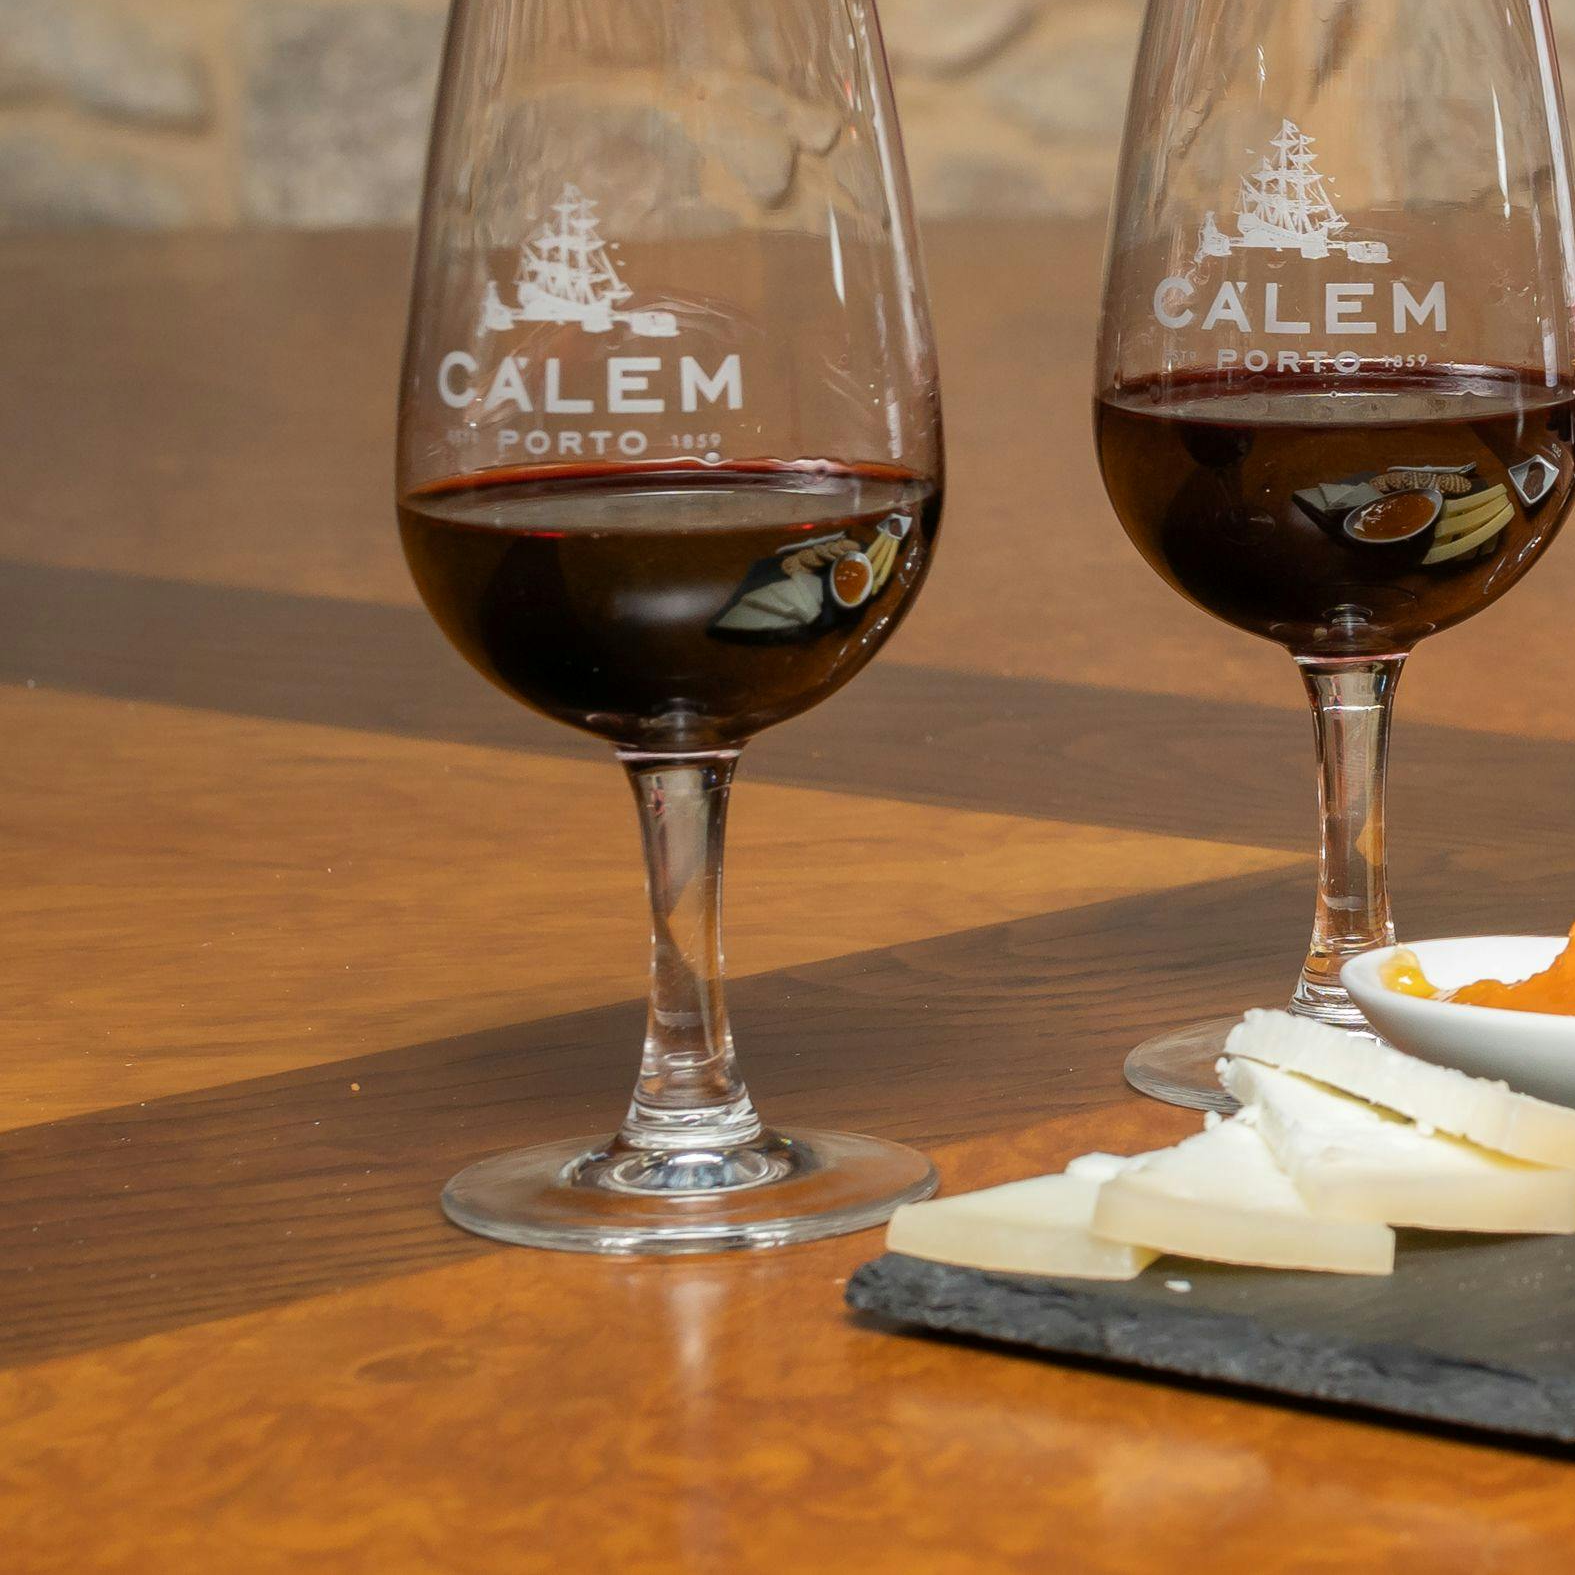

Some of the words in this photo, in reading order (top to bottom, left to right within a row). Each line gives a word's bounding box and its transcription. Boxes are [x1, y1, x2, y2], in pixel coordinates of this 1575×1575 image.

[1216, 349, 1361, 373] PORTO
[1383, 353, 1429, 369] 1859
[498, 429, 648, 455] PORTO
[670, 433, 722, 450] 1859
